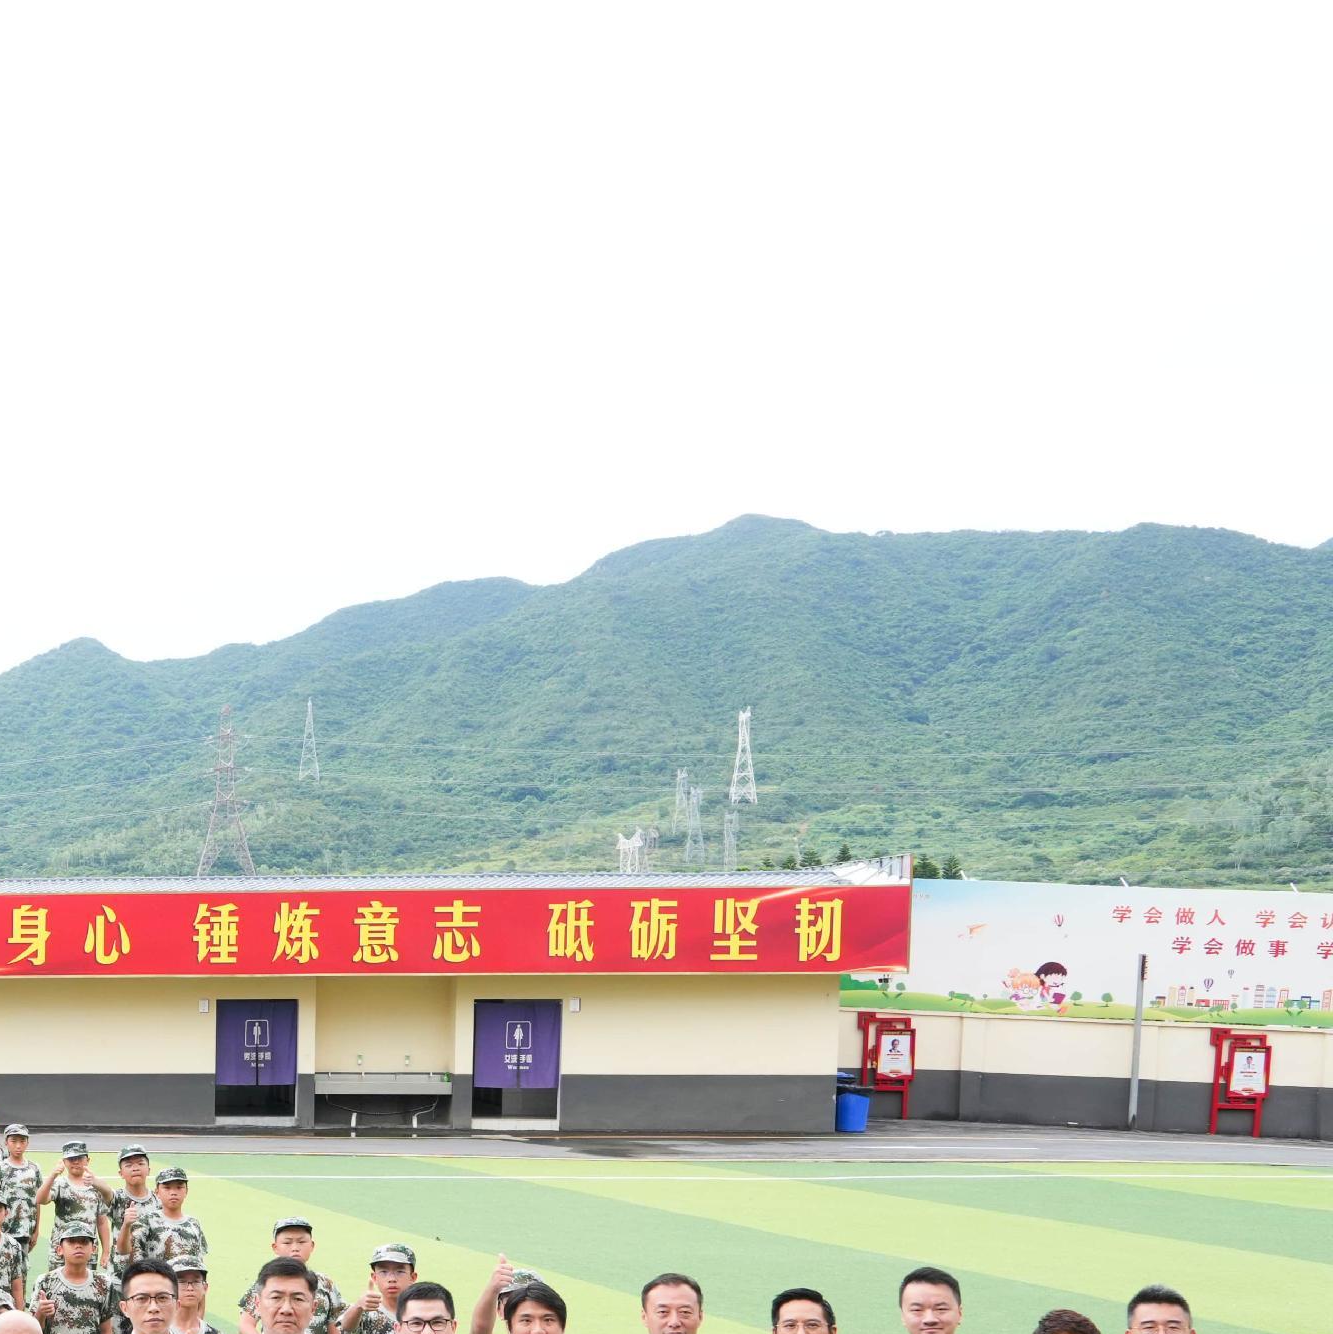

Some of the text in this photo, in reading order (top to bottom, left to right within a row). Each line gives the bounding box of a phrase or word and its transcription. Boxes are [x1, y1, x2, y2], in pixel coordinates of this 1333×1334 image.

[1112, 906, 1227, 926] 学会做人
[193, 899, 482, 964] 锤炼意志
[546, 897, 843, 963] 砥砺坚韧
[1171, 936, 1289, 958] 学会做事
